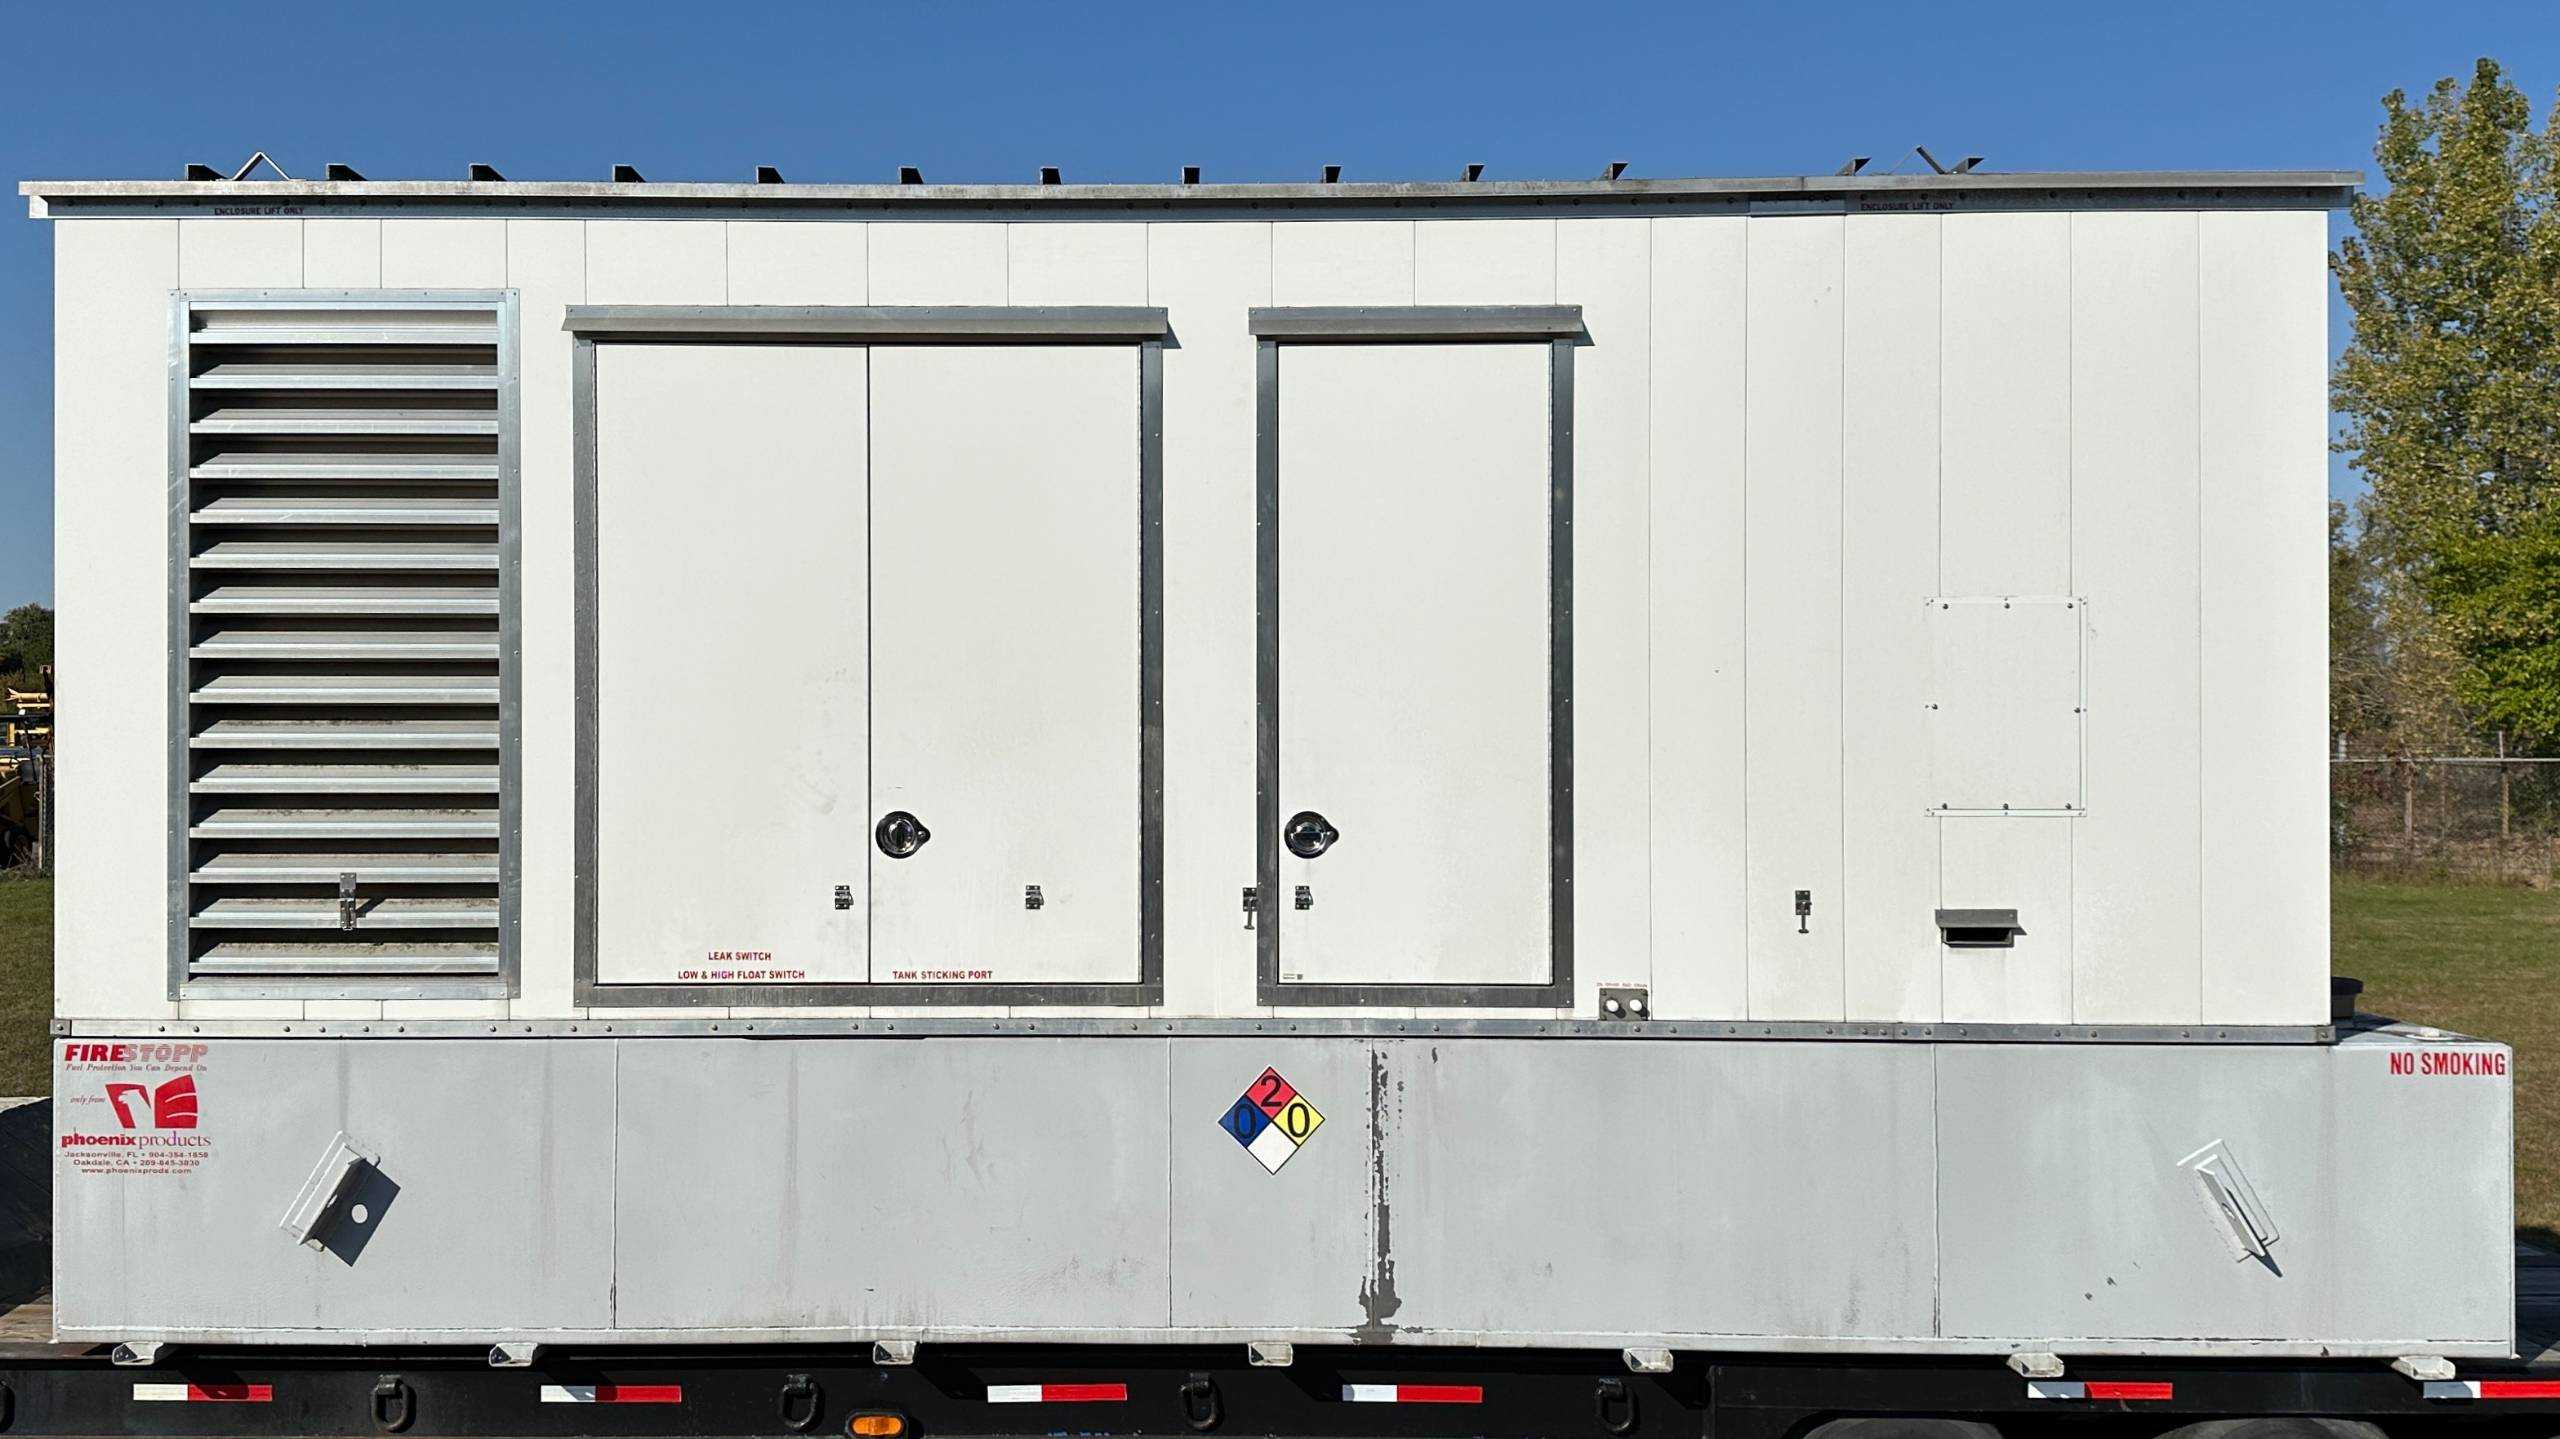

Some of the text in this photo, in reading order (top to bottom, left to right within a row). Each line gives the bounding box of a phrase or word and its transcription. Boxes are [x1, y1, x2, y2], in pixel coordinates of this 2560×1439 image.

[214, 207, 304, 216] ENCLOSURE LIFT ONLY
[708, 952, 772, 961] LEAK SWITCH
[678, 970, 805, 979] LOW & HIGH FLOAT SWITCH
[892, 970, 993, 979] TANK STICKING PORT
[66, 1063, 207, 1072] Fuel Protection You Can Depend On
[2390, 1052, 2506, 1075] NO SMOKING
[1260, 1075, 1282, 1107] 2
[70, 1094, 105, 1105] only from
[1234, 1102, 1310, 1139] 0 0
